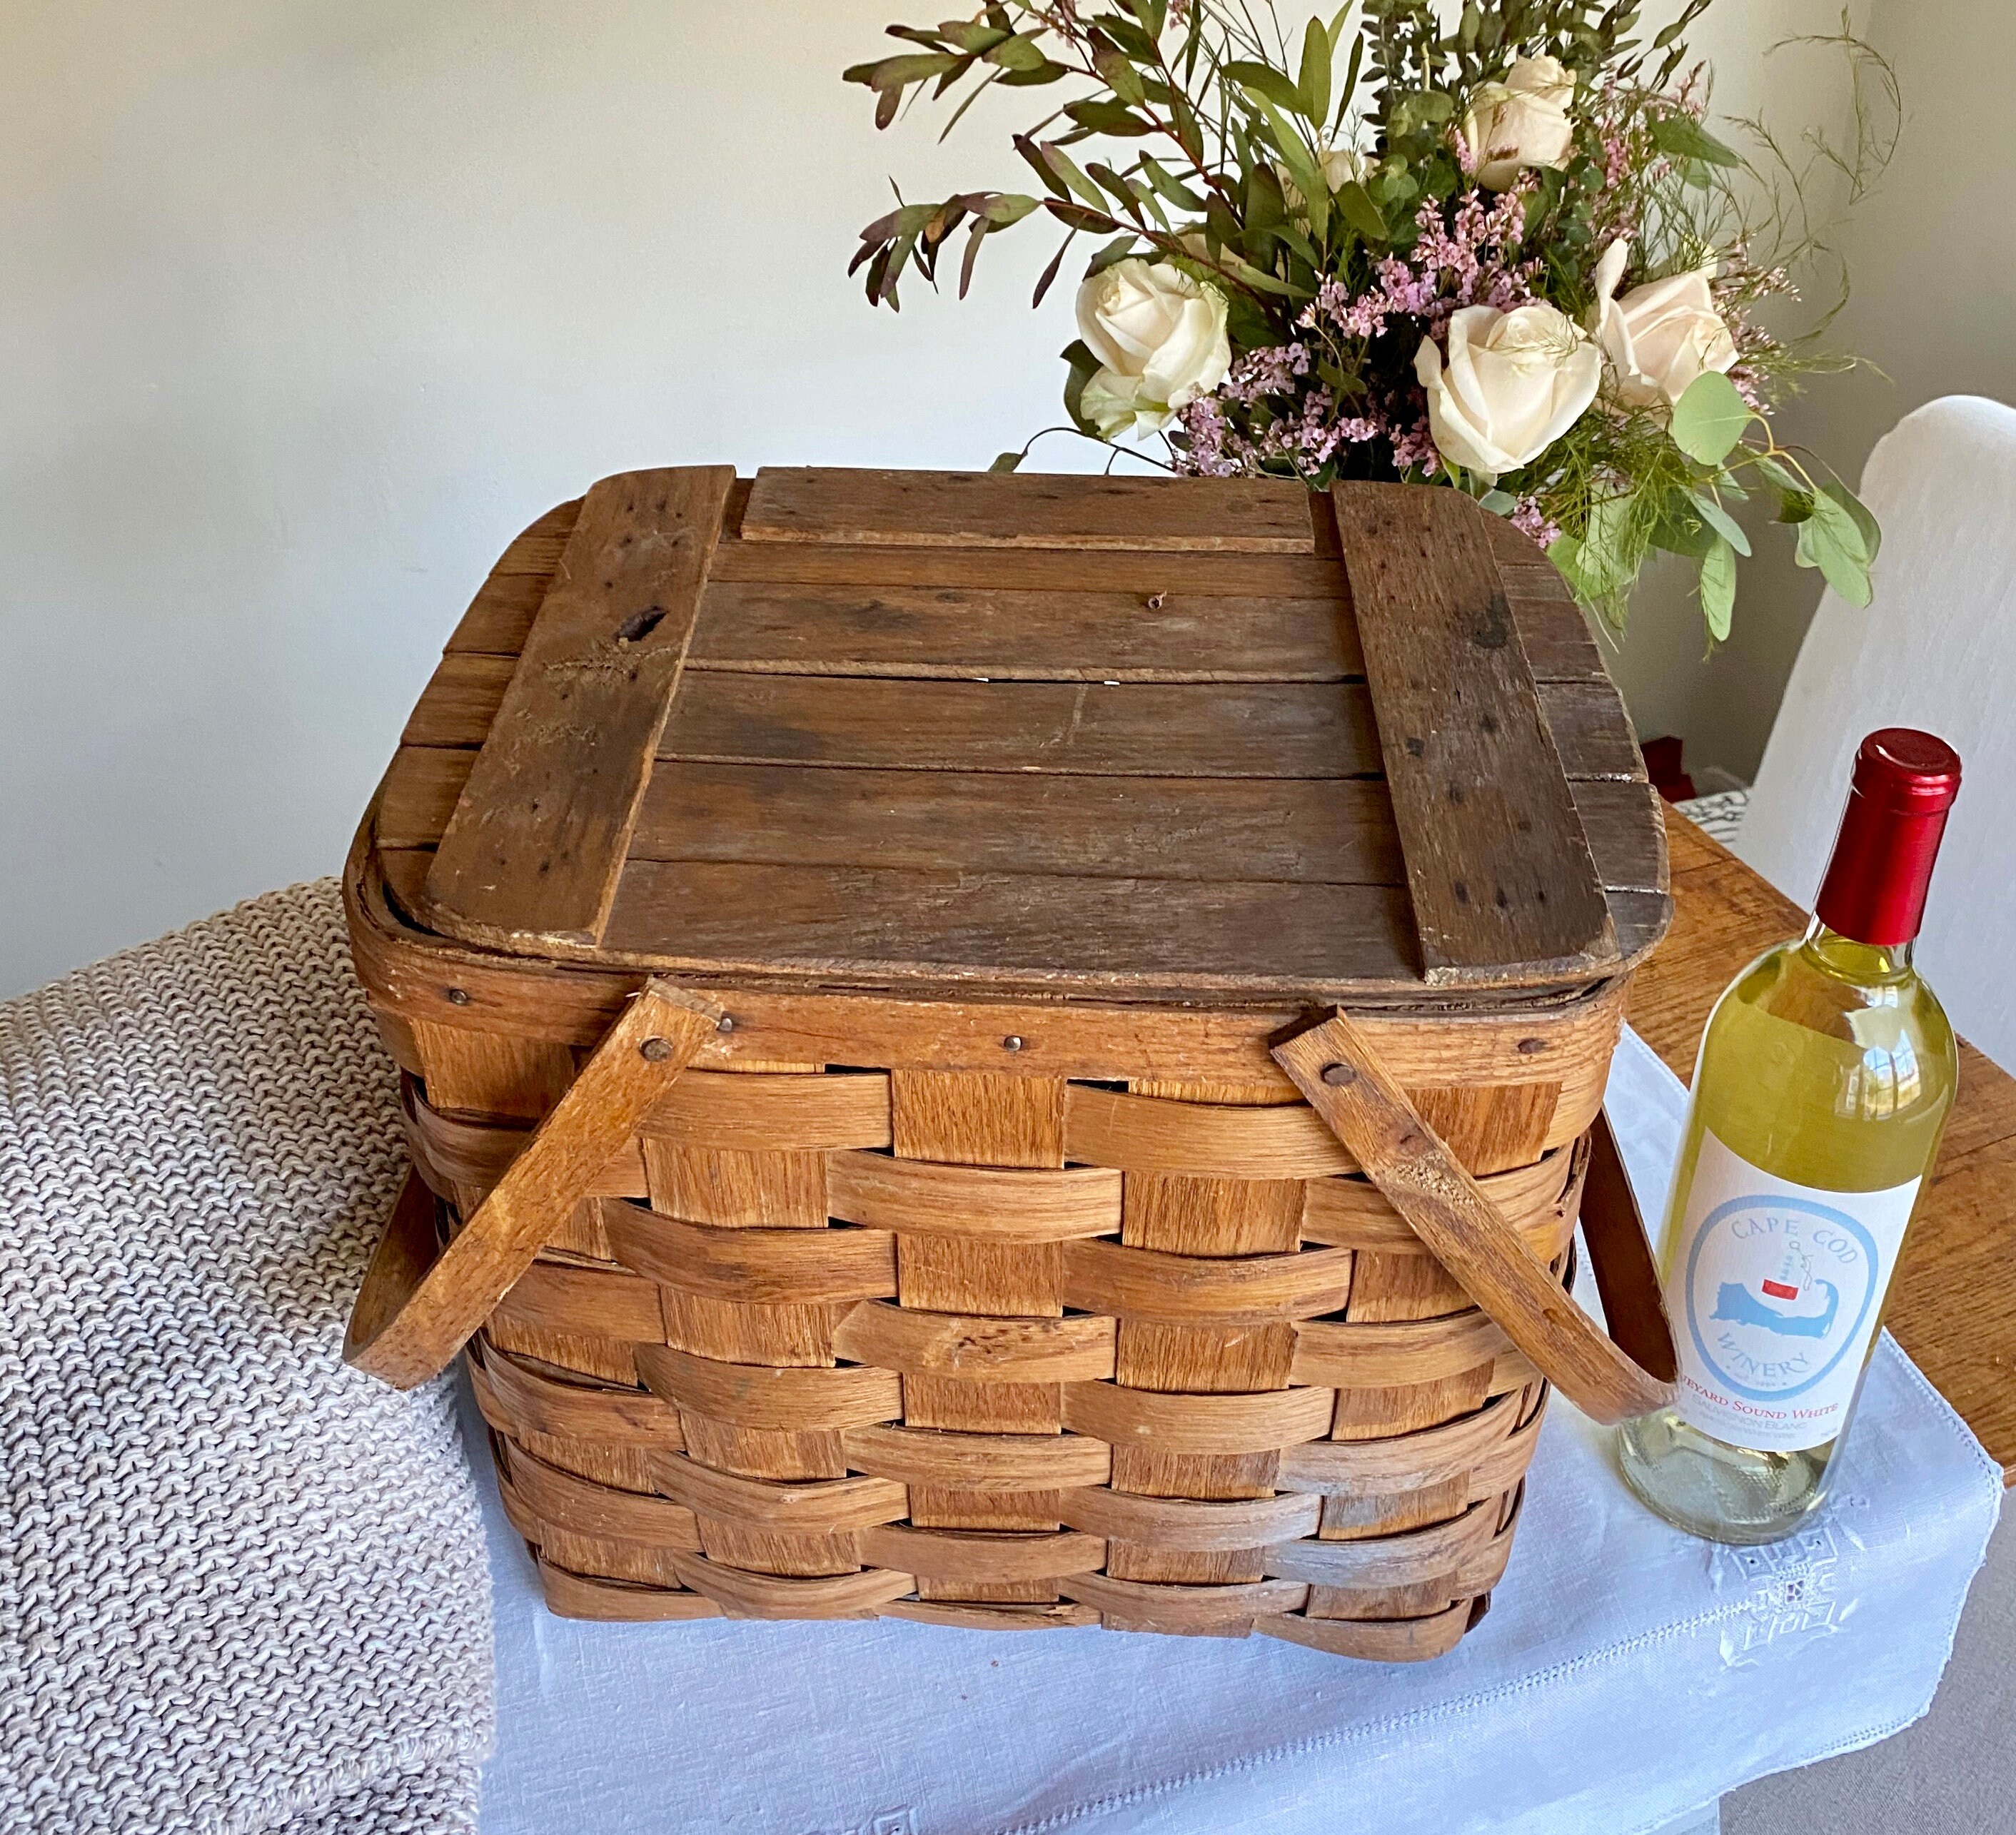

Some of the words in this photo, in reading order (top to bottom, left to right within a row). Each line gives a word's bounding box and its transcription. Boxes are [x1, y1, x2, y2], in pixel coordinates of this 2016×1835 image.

[1730, 1217, 1800, 1240] CAPE
[1812, 1229, 1858, 1265] COD
[1716, 1332, 1812, 1377] WINERY
[1733, 1400, 1787, 1420] SOUND
[1791, 1402, 1839, 1420] WHITE
[1765, 1418, 1808, 1430] BLANC
